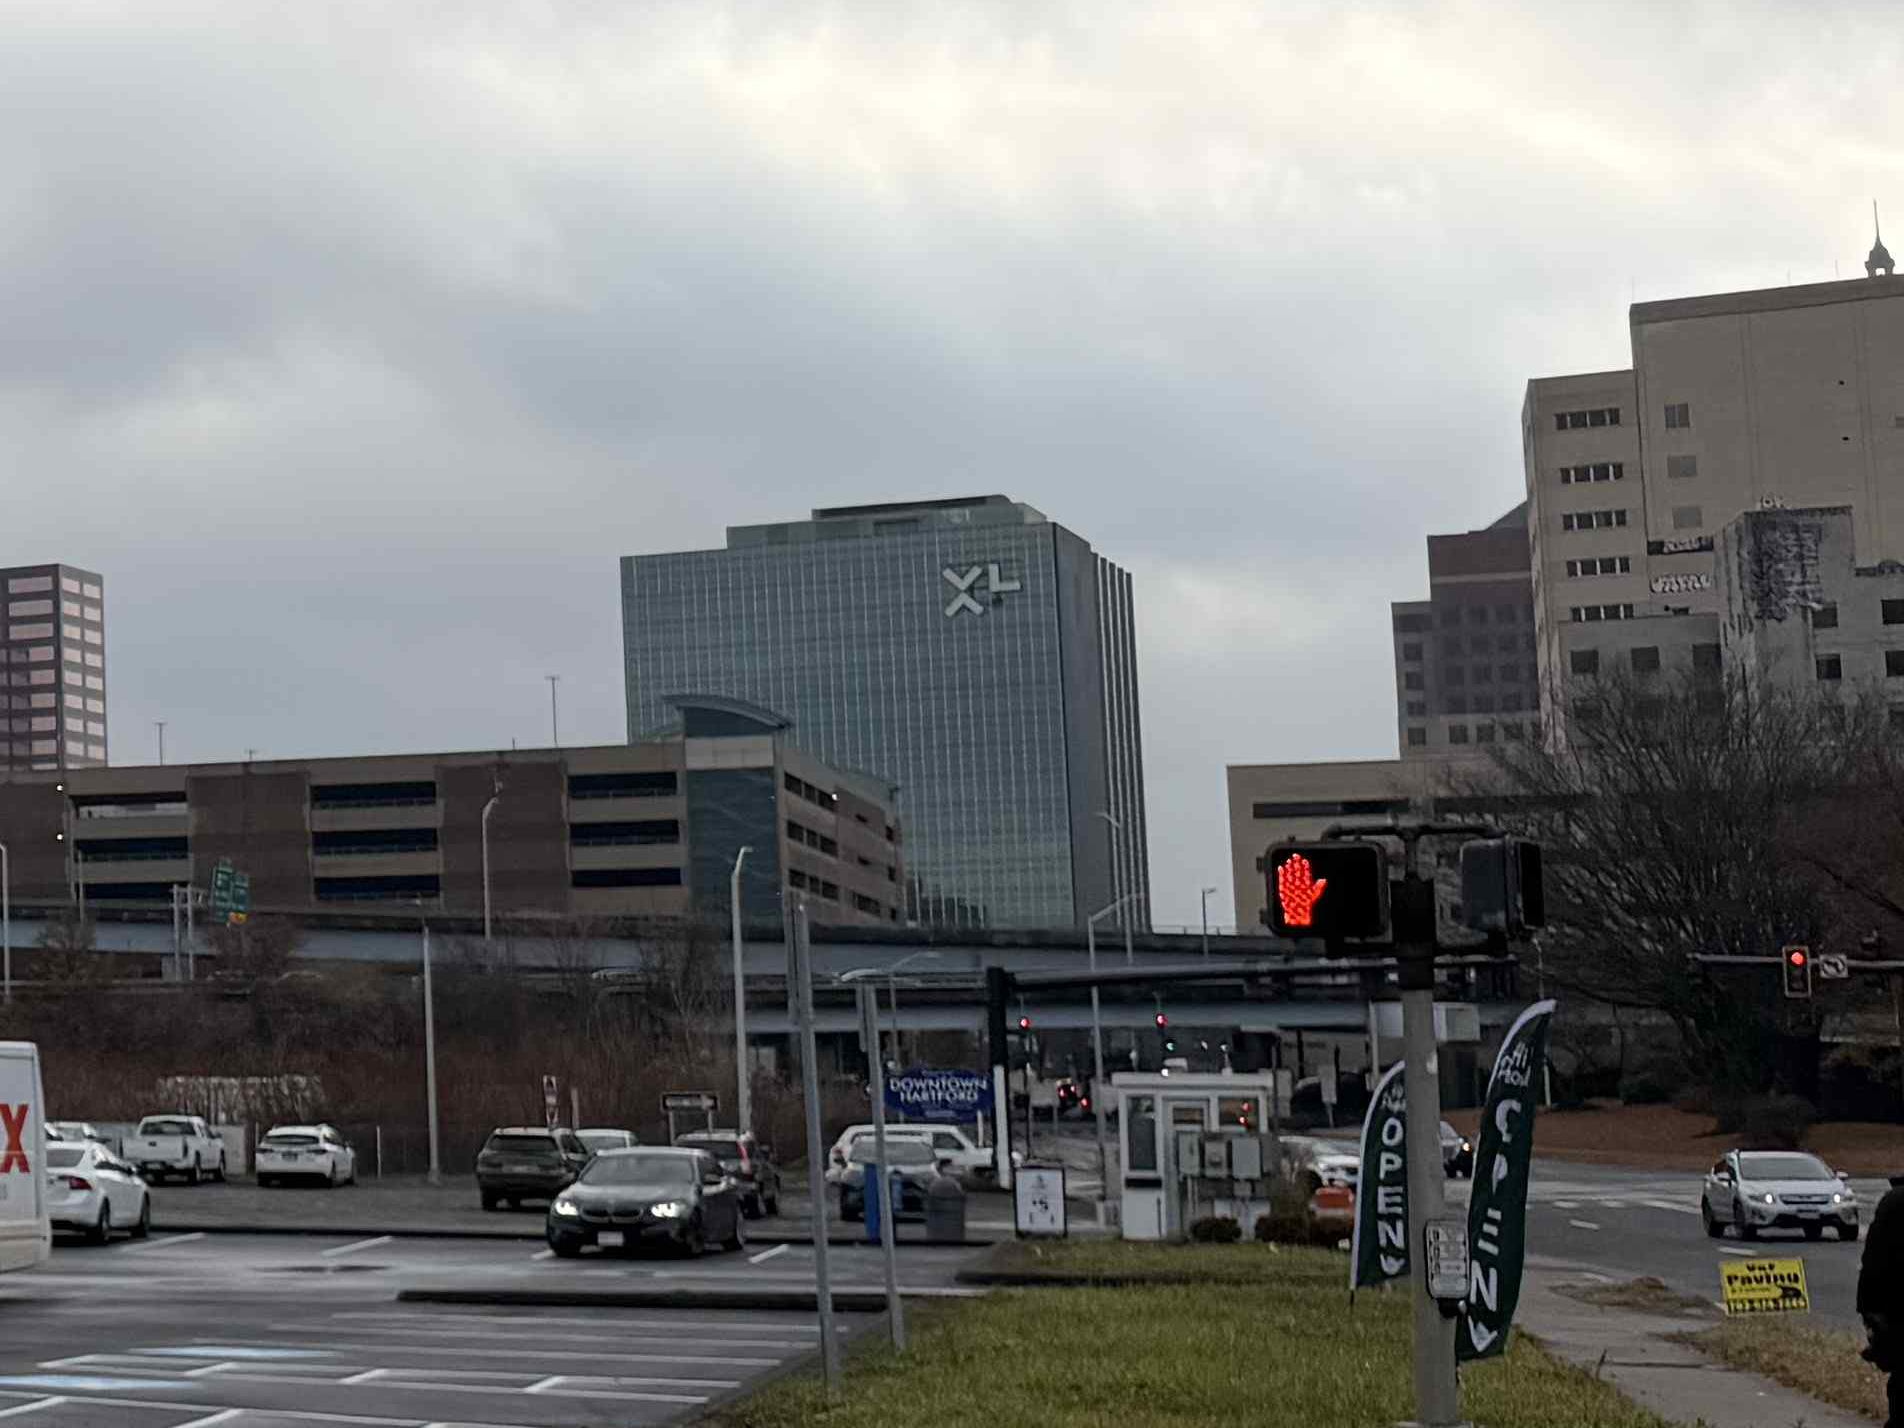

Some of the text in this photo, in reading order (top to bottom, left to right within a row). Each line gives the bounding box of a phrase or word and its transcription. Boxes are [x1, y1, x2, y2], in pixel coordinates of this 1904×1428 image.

[942, 563, 1021, 618] XL
[889, 1076, 988, 1092] DOWNTOWN
[900, 1091, 979, 1103] HARTFORD
[1377, 1117, 1406, 1250] OPEN
